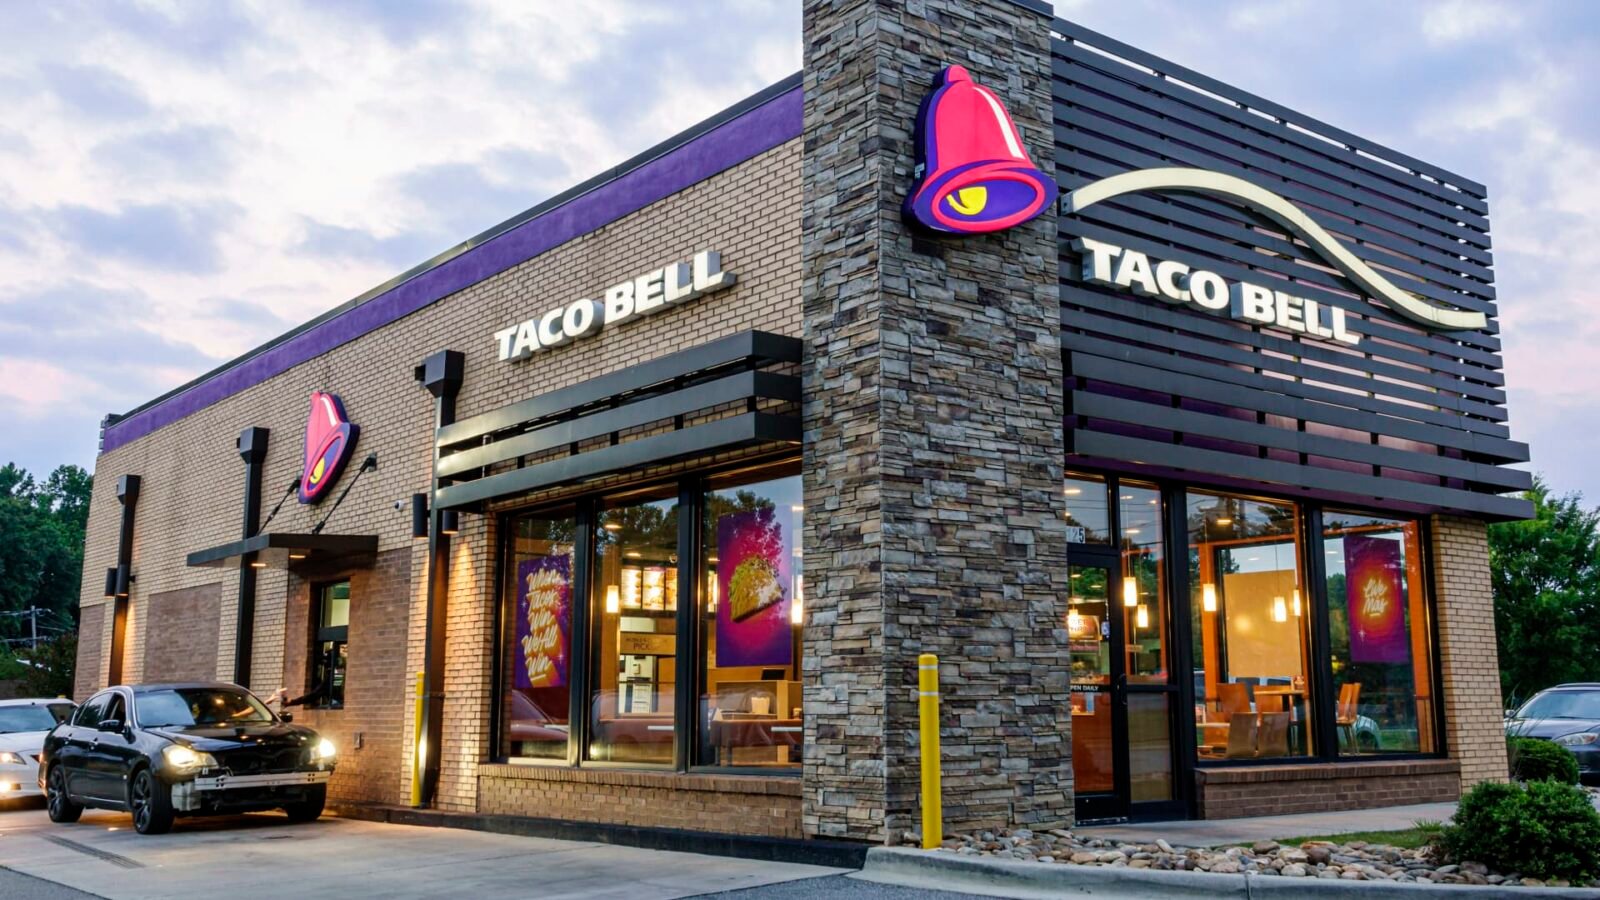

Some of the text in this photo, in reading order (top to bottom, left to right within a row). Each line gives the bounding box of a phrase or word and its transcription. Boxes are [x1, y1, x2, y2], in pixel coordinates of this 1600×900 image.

[493, 250, 735, 362] TACO BELL
[1078, 236, 1360, 345] TACO BELL
[1083, 684, 1099, 692] DAILY
